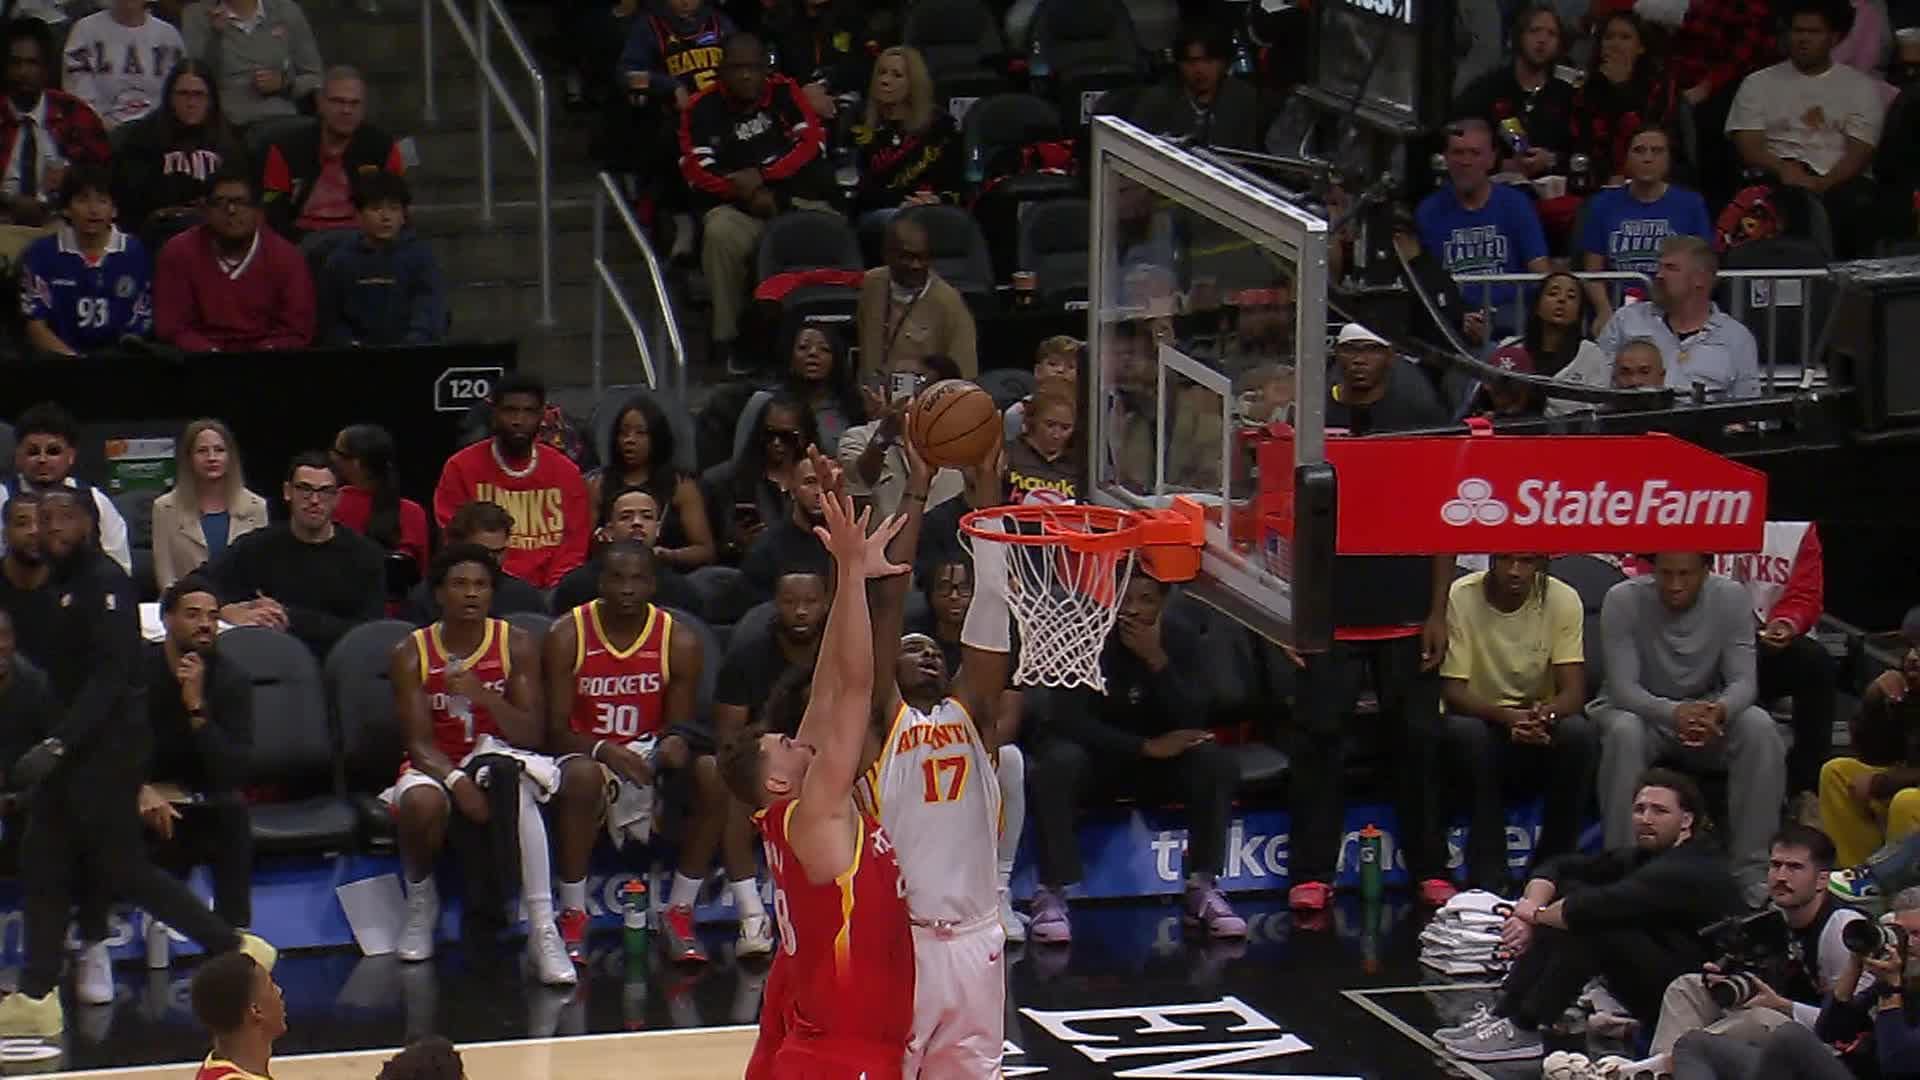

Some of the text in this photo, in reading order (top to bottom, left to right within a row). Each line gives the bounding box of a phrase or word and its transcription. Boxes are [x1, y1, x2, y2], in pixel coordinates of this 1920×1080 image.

[666, 47, 723, 76] HAWK
[77, 297, 109, 328] 93
[448, 379, 489, 399] 120
[579, 672, 660, 696] ROCKETS
[592, 702, 639, 736] 30
[922, 754, 970, 803] 17
